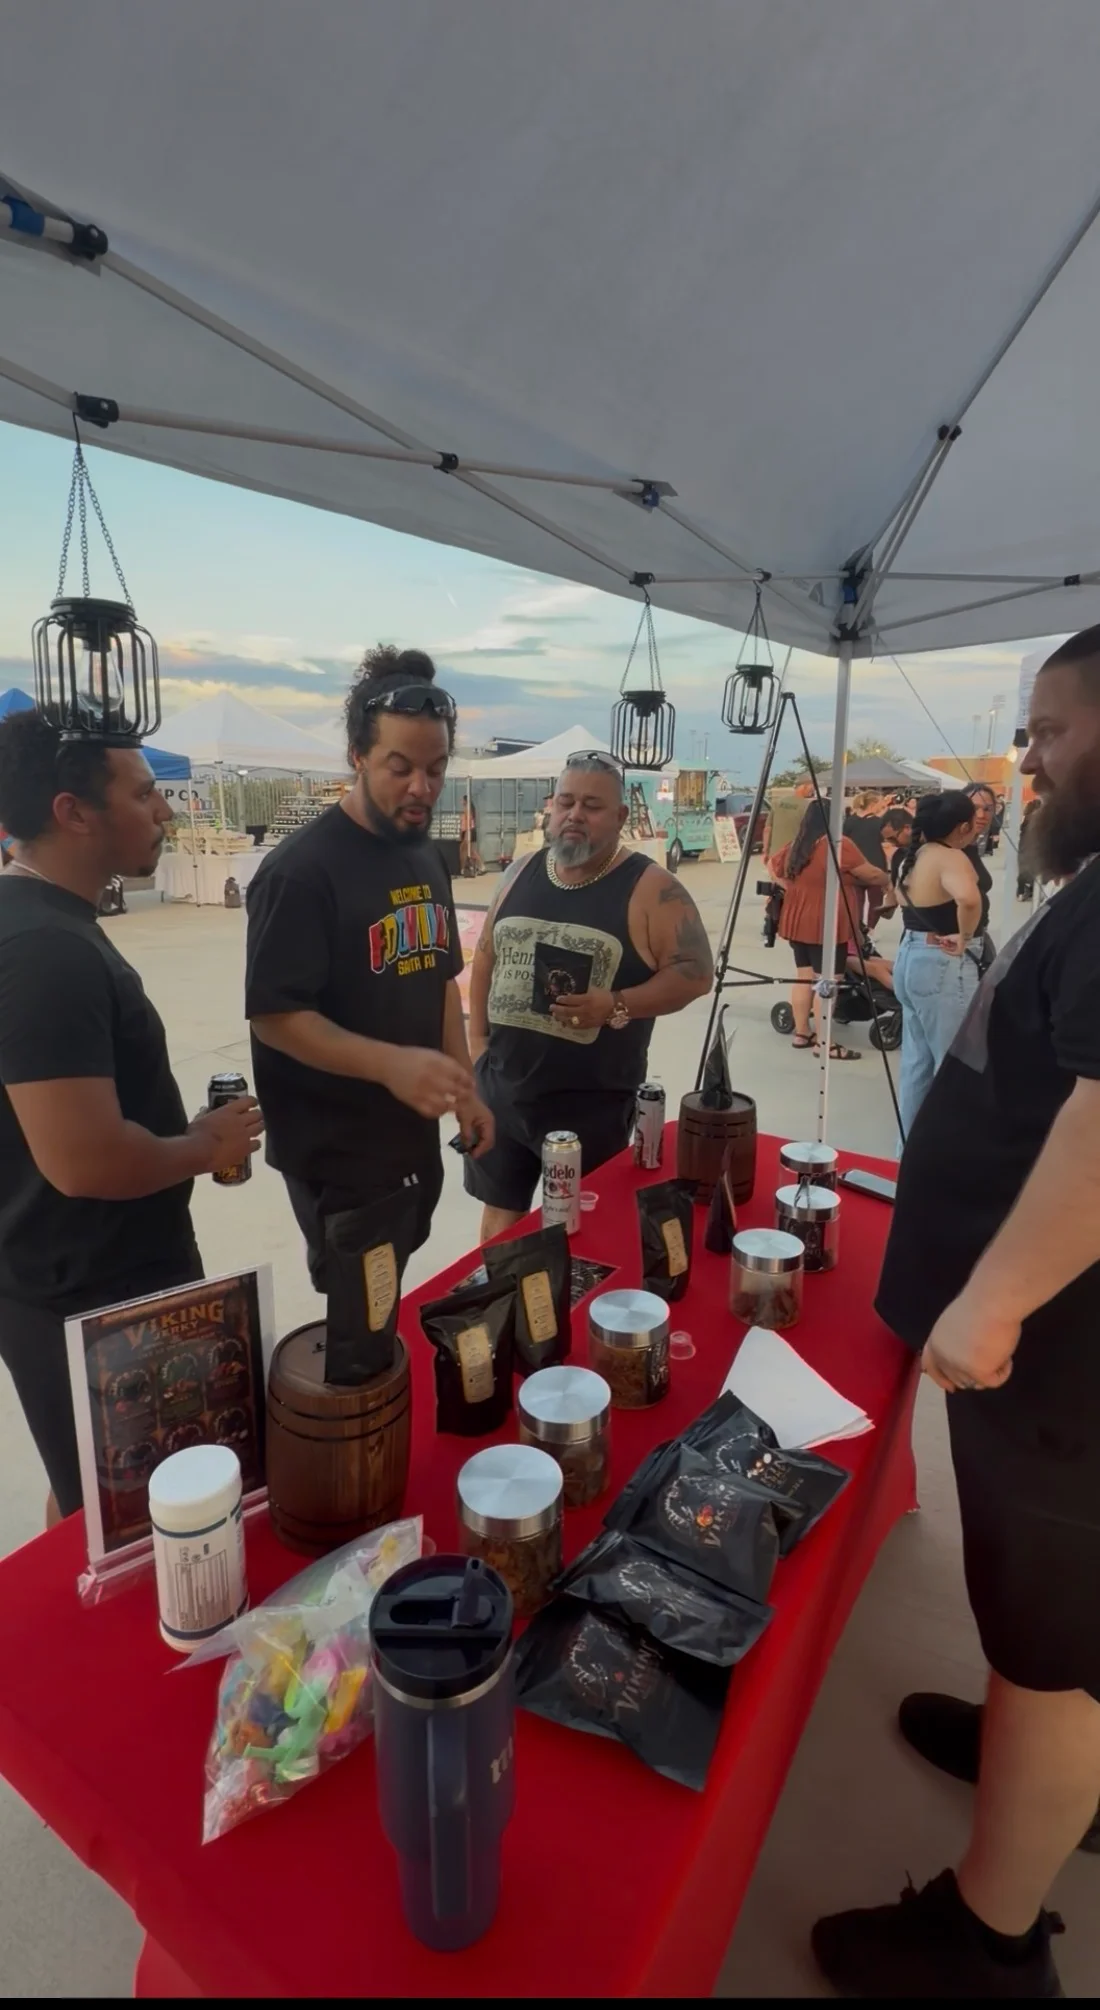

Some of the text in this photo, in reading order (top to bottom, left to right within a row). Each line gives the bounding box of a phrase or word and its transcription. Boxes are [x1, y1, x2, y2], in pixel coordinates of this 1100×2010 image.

[390, 886, 423, 905] WELCOME
[502, 946, 535, 965] Henn
[514, 969, 534, 981] POS
[542, 1164, 575, 1180] odelo
[123, 1300, 225, 1350] VIKING
[704, 1486, 737, 1548] VIKIN
